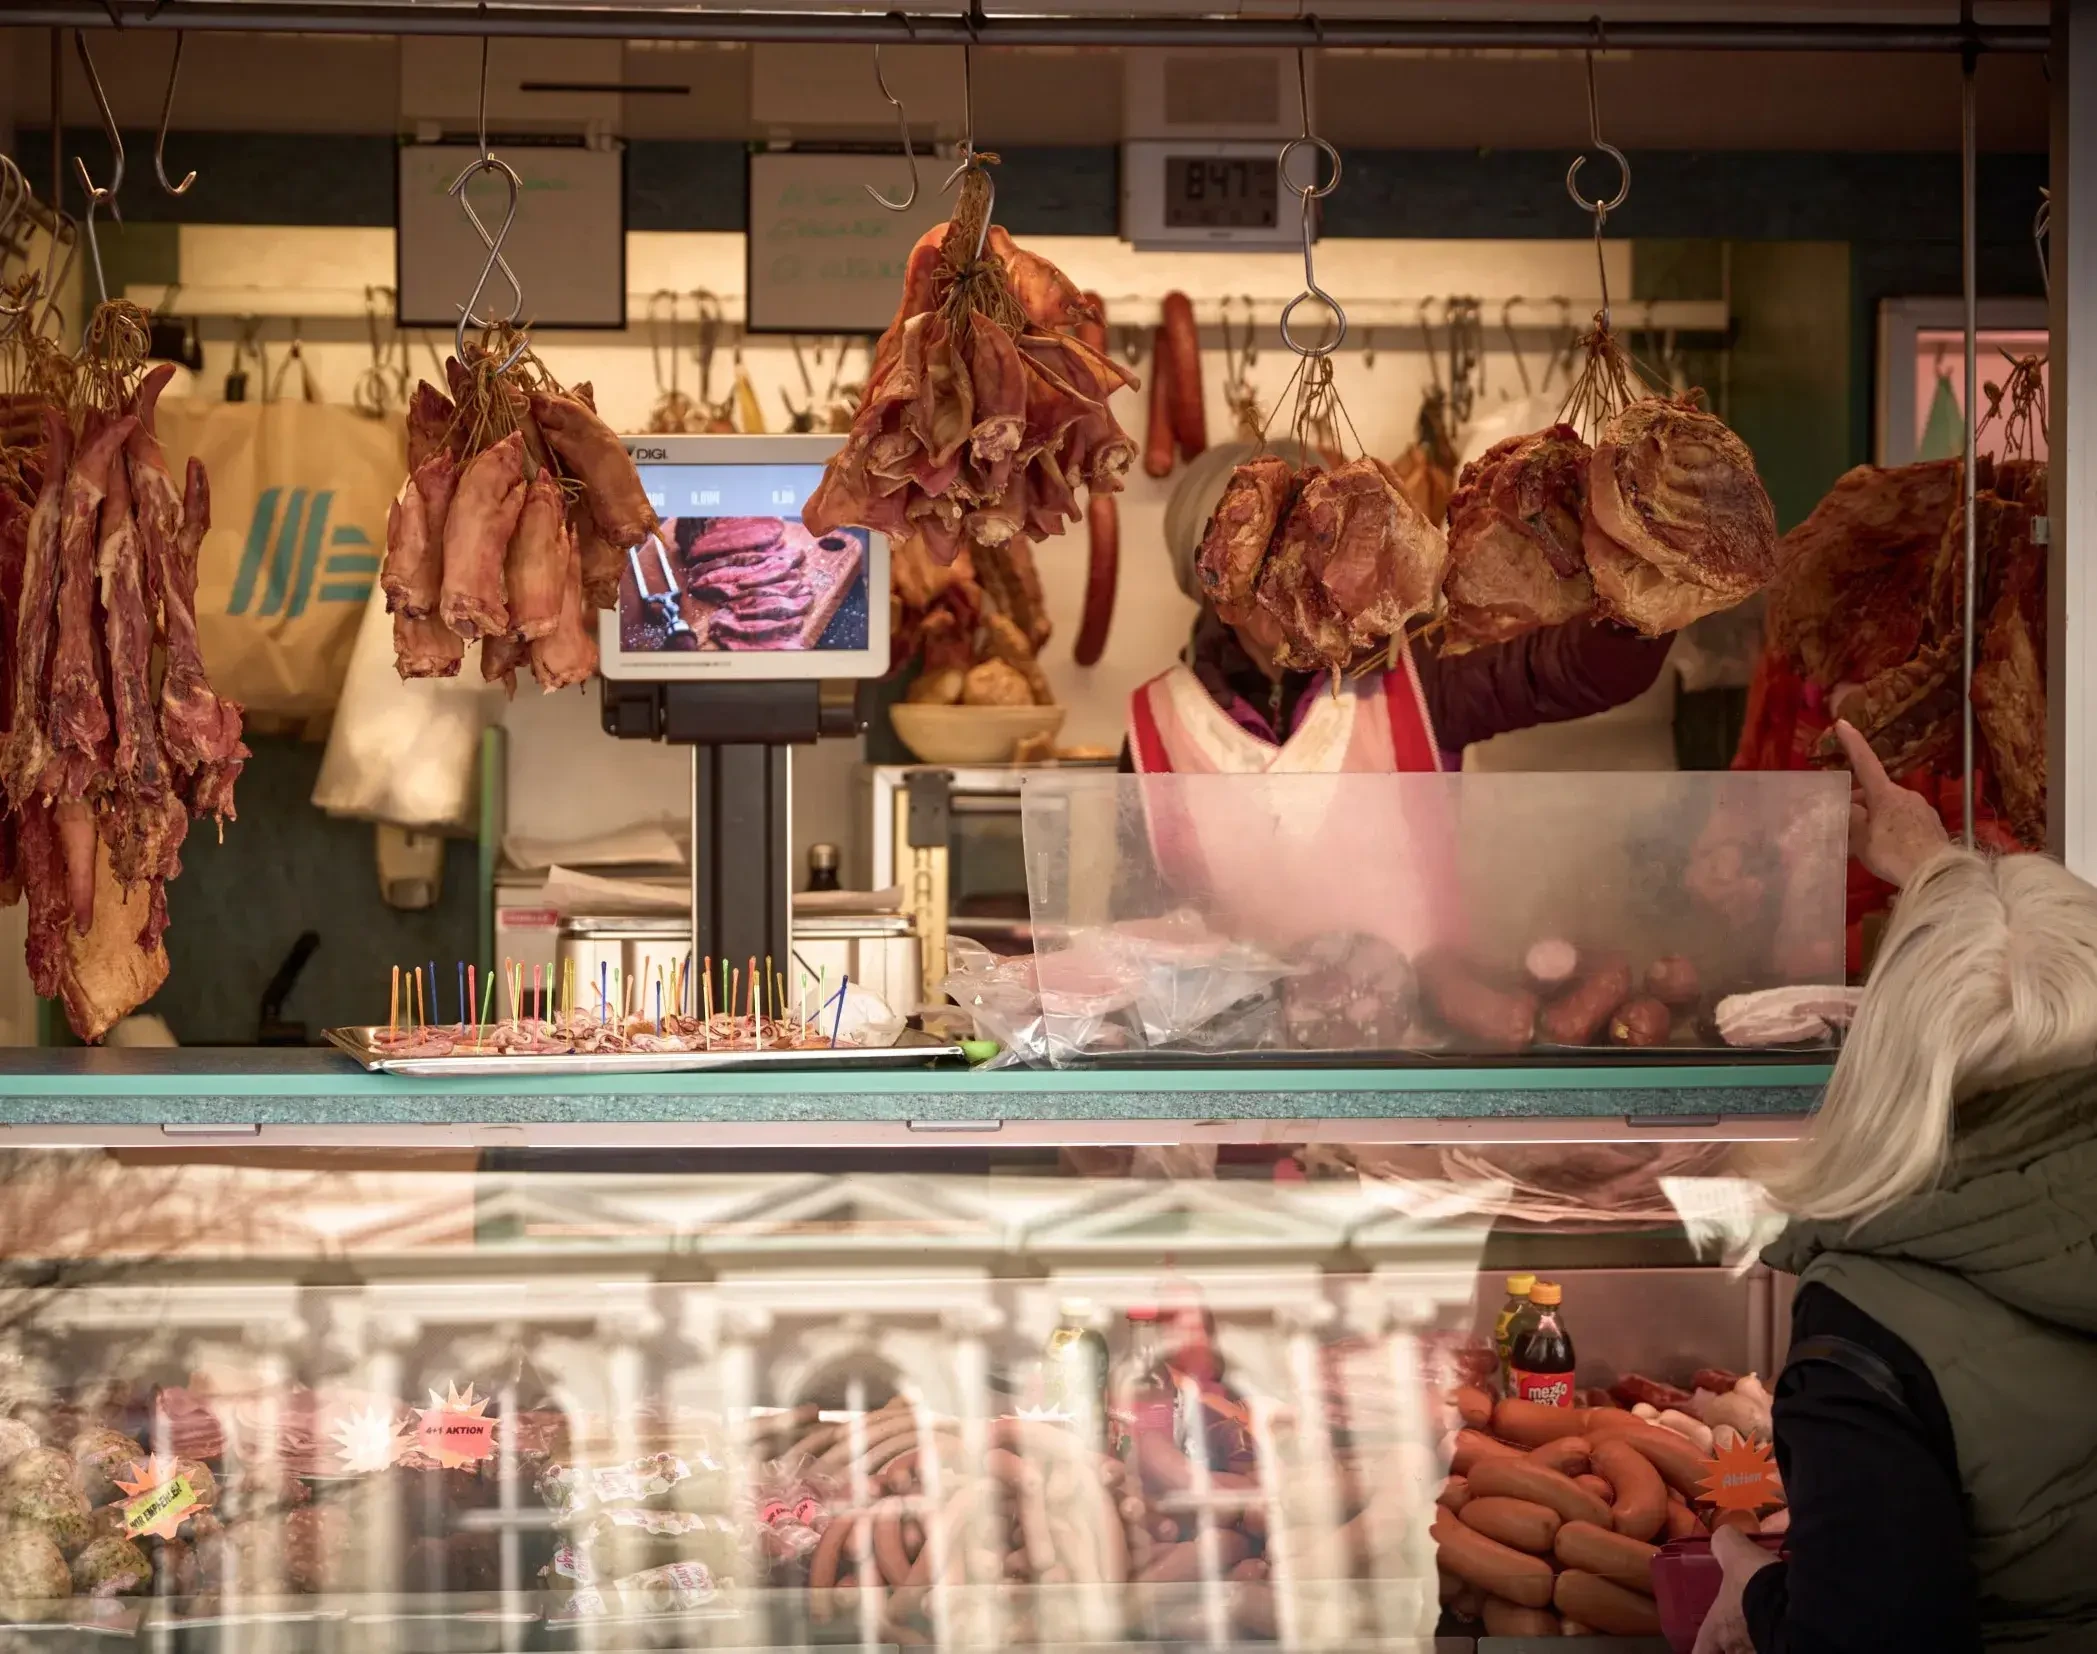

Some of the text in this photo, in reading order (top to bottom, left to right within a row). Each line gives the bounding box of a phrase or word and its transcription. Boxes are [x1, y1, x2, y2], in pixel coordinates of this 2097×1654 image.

[636, 448, 666, 460] DIGI
[1528, 1381, 1567, 1399] mezzo
[446, 1426, 484, 1435] AKTION
